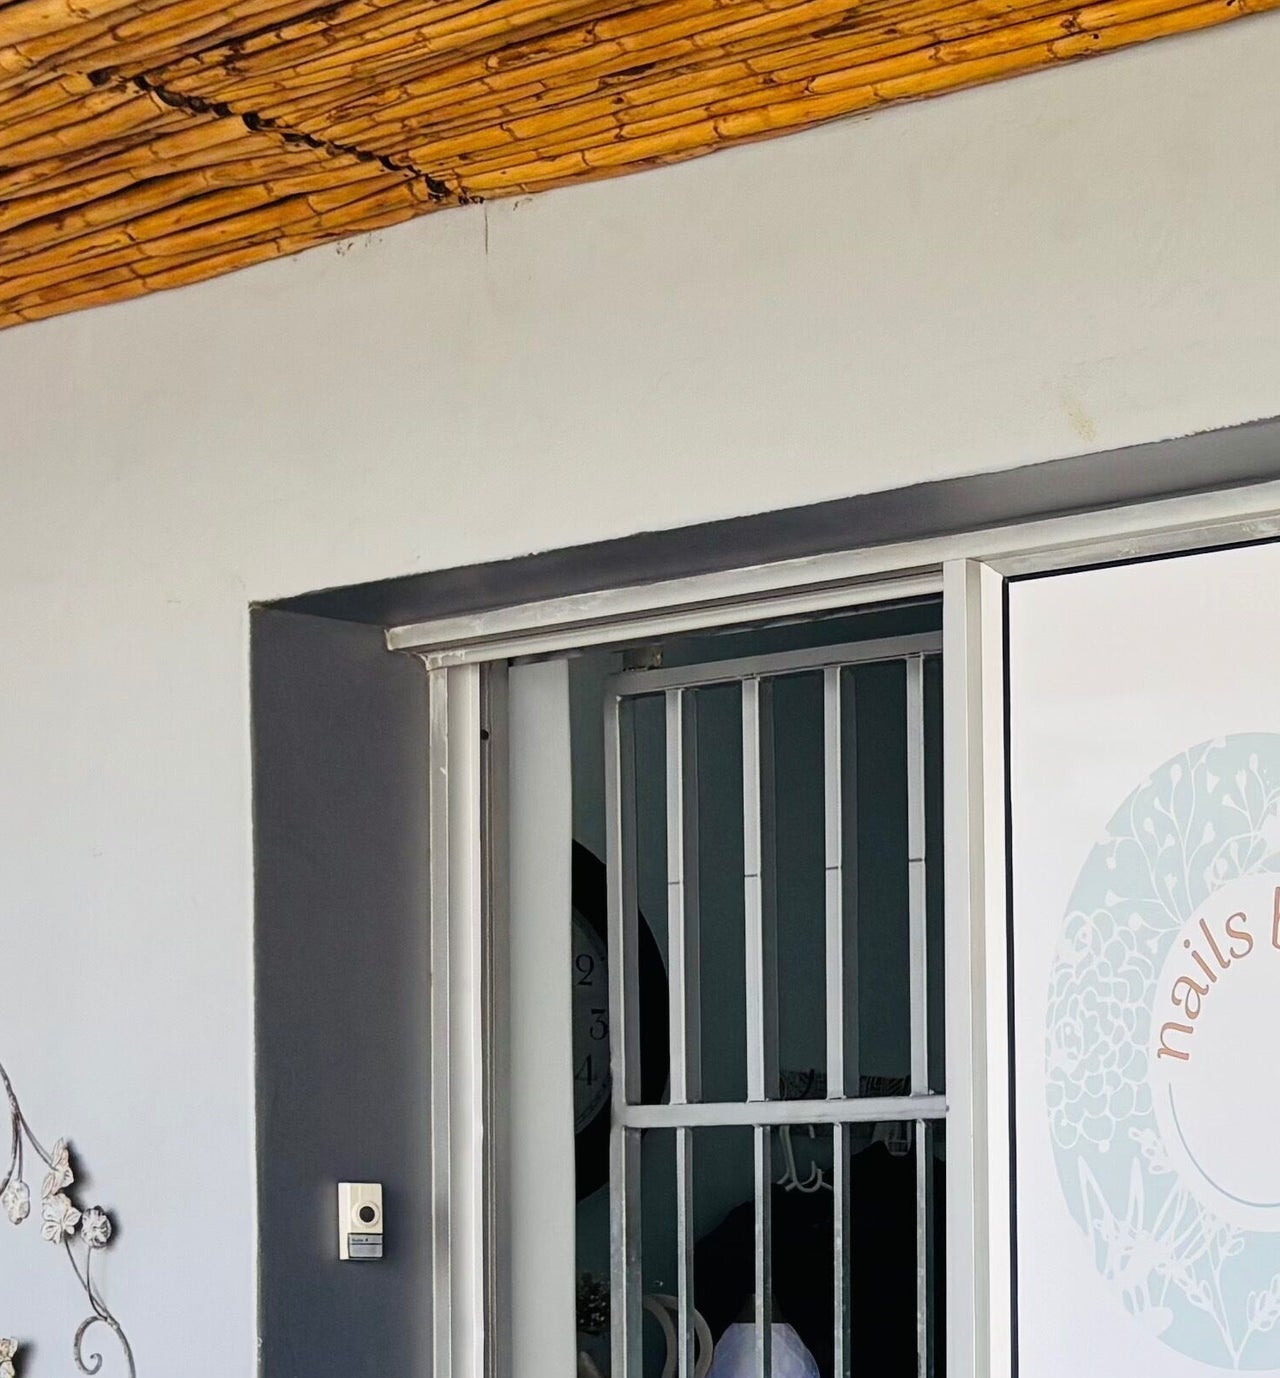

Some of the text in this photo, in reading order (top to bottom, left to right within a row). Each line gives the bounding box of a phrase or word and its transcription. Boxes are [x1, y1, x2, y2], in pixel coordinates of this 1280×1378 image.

[575, 953, 594, 987] 2
[1156, 910, 1255, 1062] nails
[589, 1007, 608, 1041] 3
[574, 1054, 598, 1087] 4
